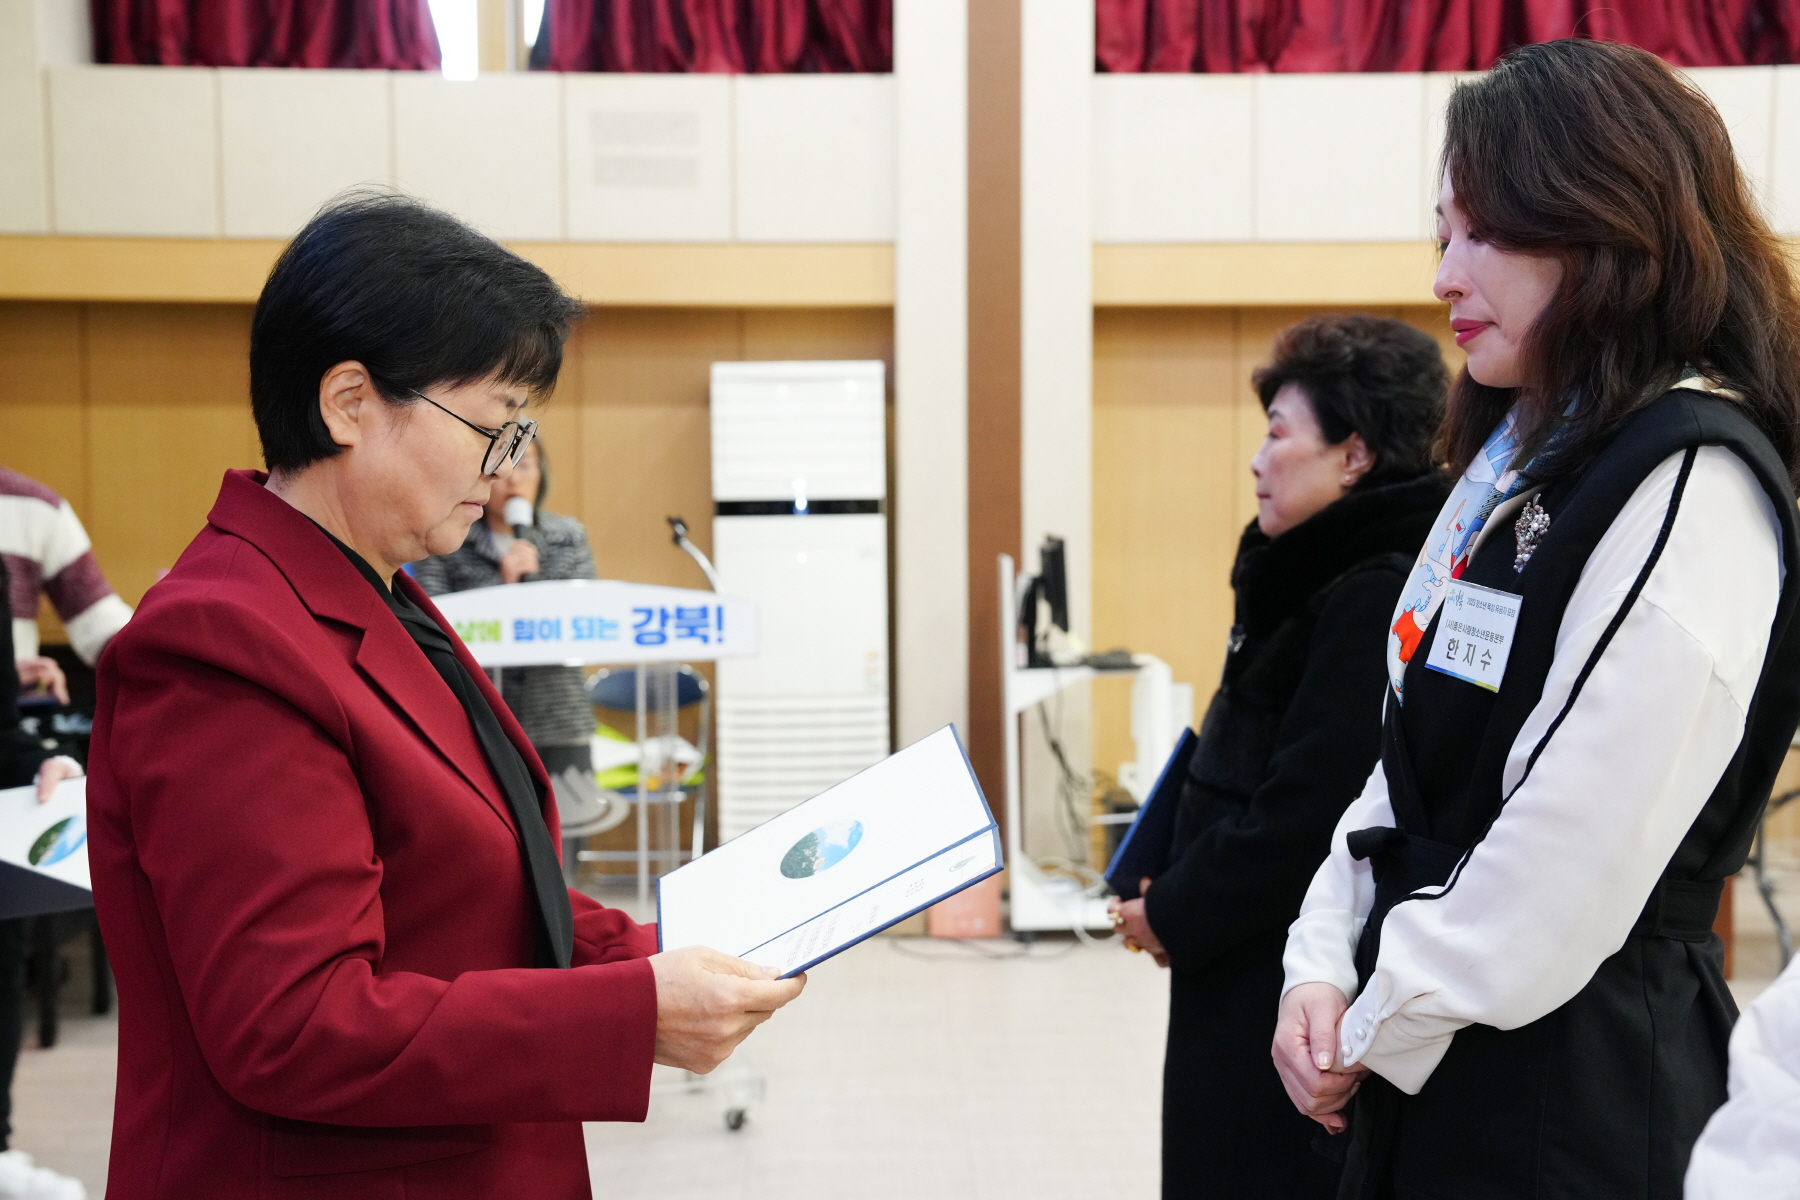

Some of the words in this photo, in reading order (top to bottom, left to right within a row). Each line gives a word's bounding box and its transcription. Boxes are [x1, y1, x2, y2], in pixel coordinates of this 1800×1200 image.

[1475, 599, 1487, 610] 청소년
[513, 618, 561, 641] 힘이
[571, 616, 618, 640] 되는
[632, 606, 724, 645] 강북!
